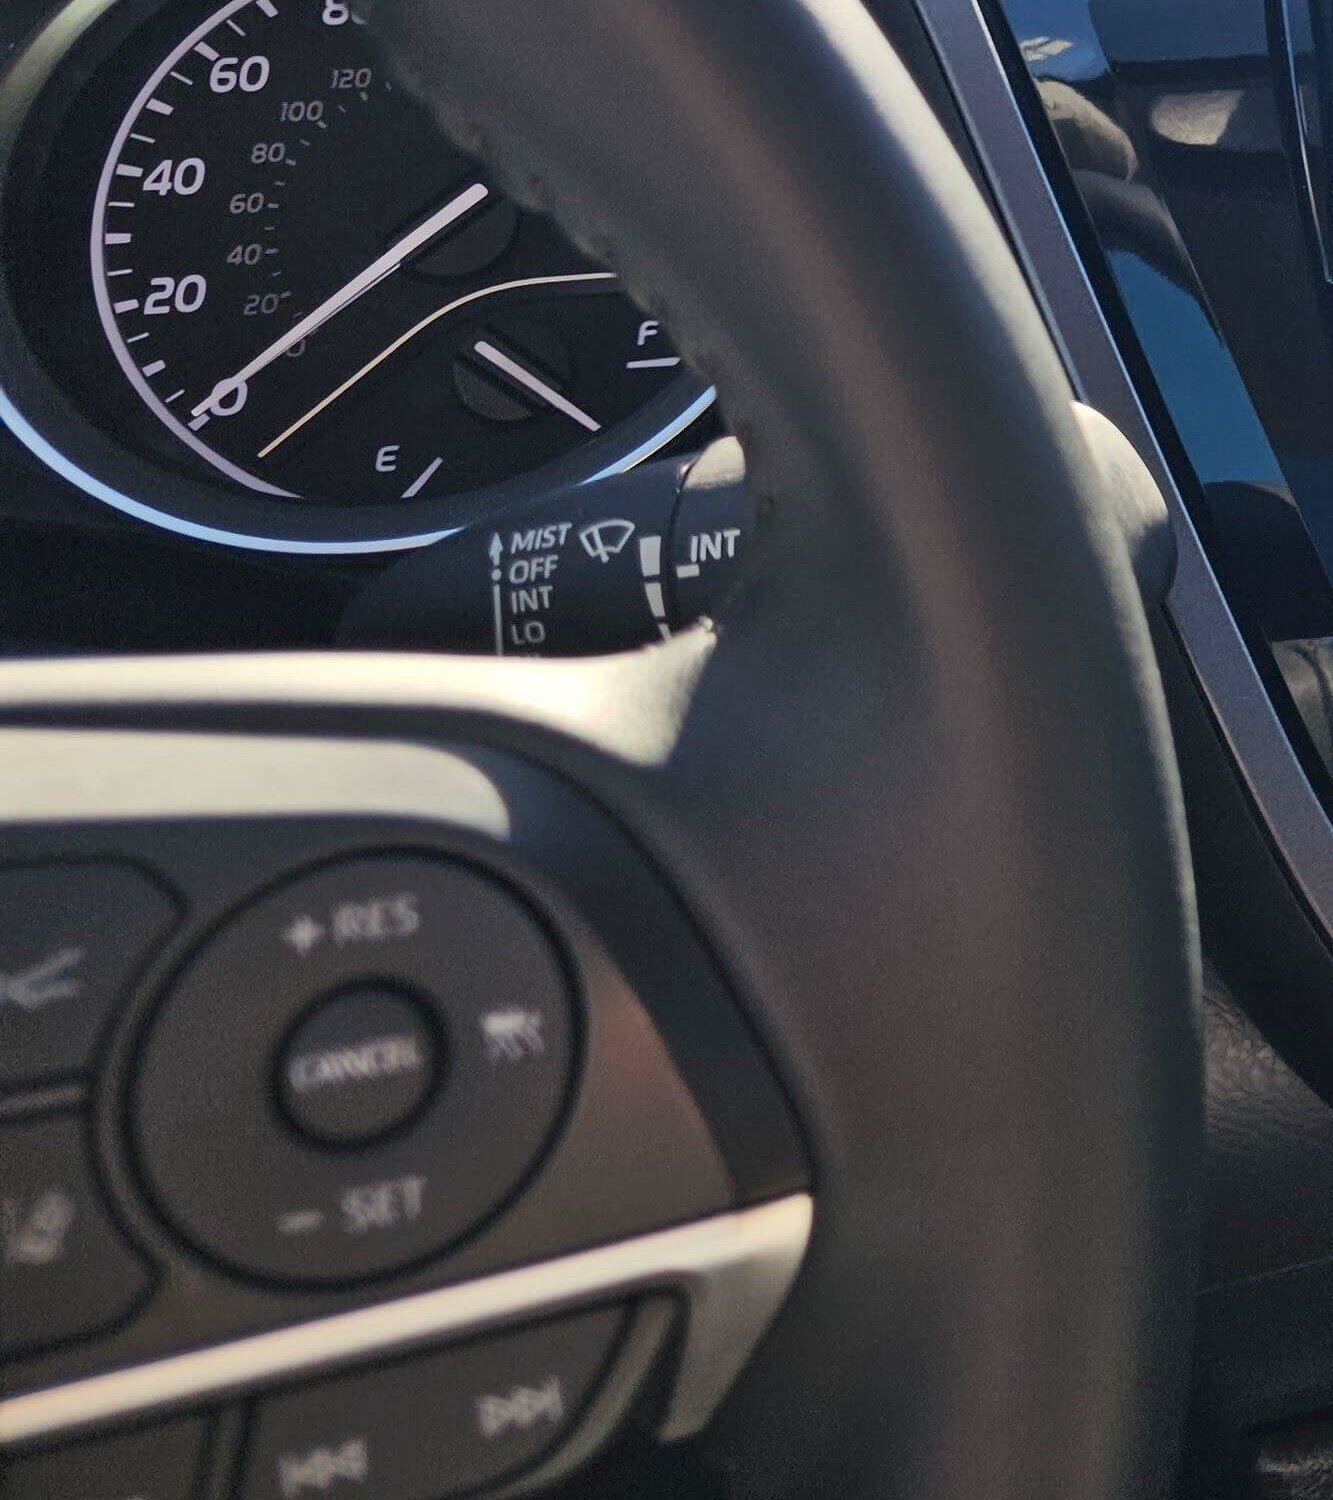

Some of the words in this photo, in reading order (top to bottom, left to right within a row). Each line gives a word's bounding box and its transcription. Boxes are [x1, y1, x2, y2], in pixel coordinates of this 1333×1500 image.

[209, 54, 271, 94] 60
[330, 67, 373, 89] 120
[279, 99, 324, 123] 100
[251, 141, 287, 165] 80
[142, 156, 207, 197] 40
[229, 191, 264, 214] 60
[226, 243, 263, 266] 40
[143, 273, 207, 315] 20
[243, 293, 278, 316] 20
[637, 320, 660, 346] F
[374, 444, 400, 473] E
[511, 522, 573, 555] MIST
[690, 528, 742, 564] INT
[508, 554, 559, 585] OFF
[510, 585, 554, 615] INT
[510, 621, 547, 646] LO
